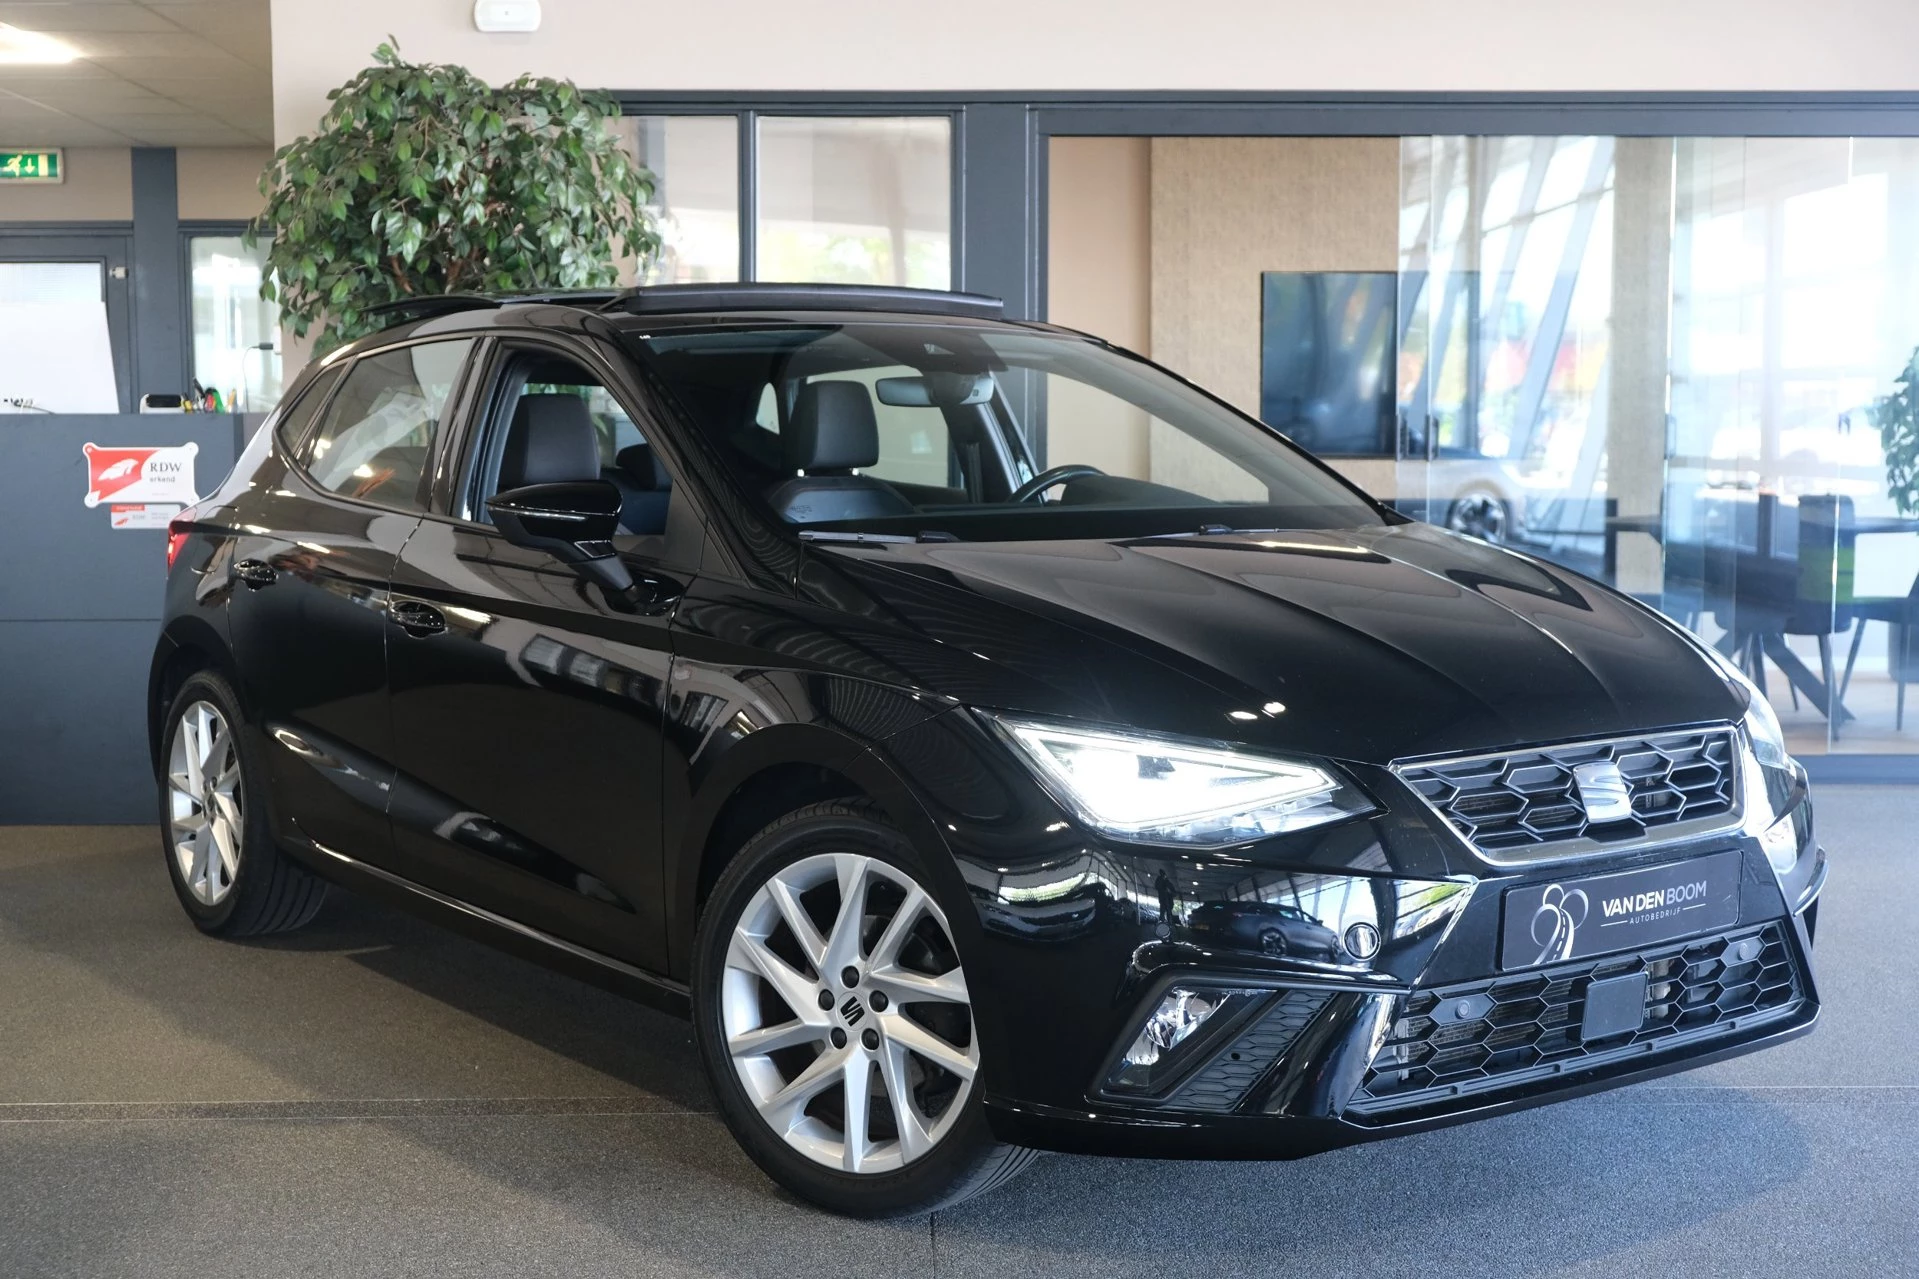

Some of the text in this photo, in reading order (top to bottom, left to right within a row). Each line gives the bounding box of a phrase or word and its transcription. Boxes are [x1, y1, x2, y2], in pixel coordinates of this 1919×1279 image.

[150, 462, 182, 472] RDW
[1602, 880, 1707, 917] VAN DEN BOOM
[1630, 906, 1681, 924] AUTOBEDRIJF
